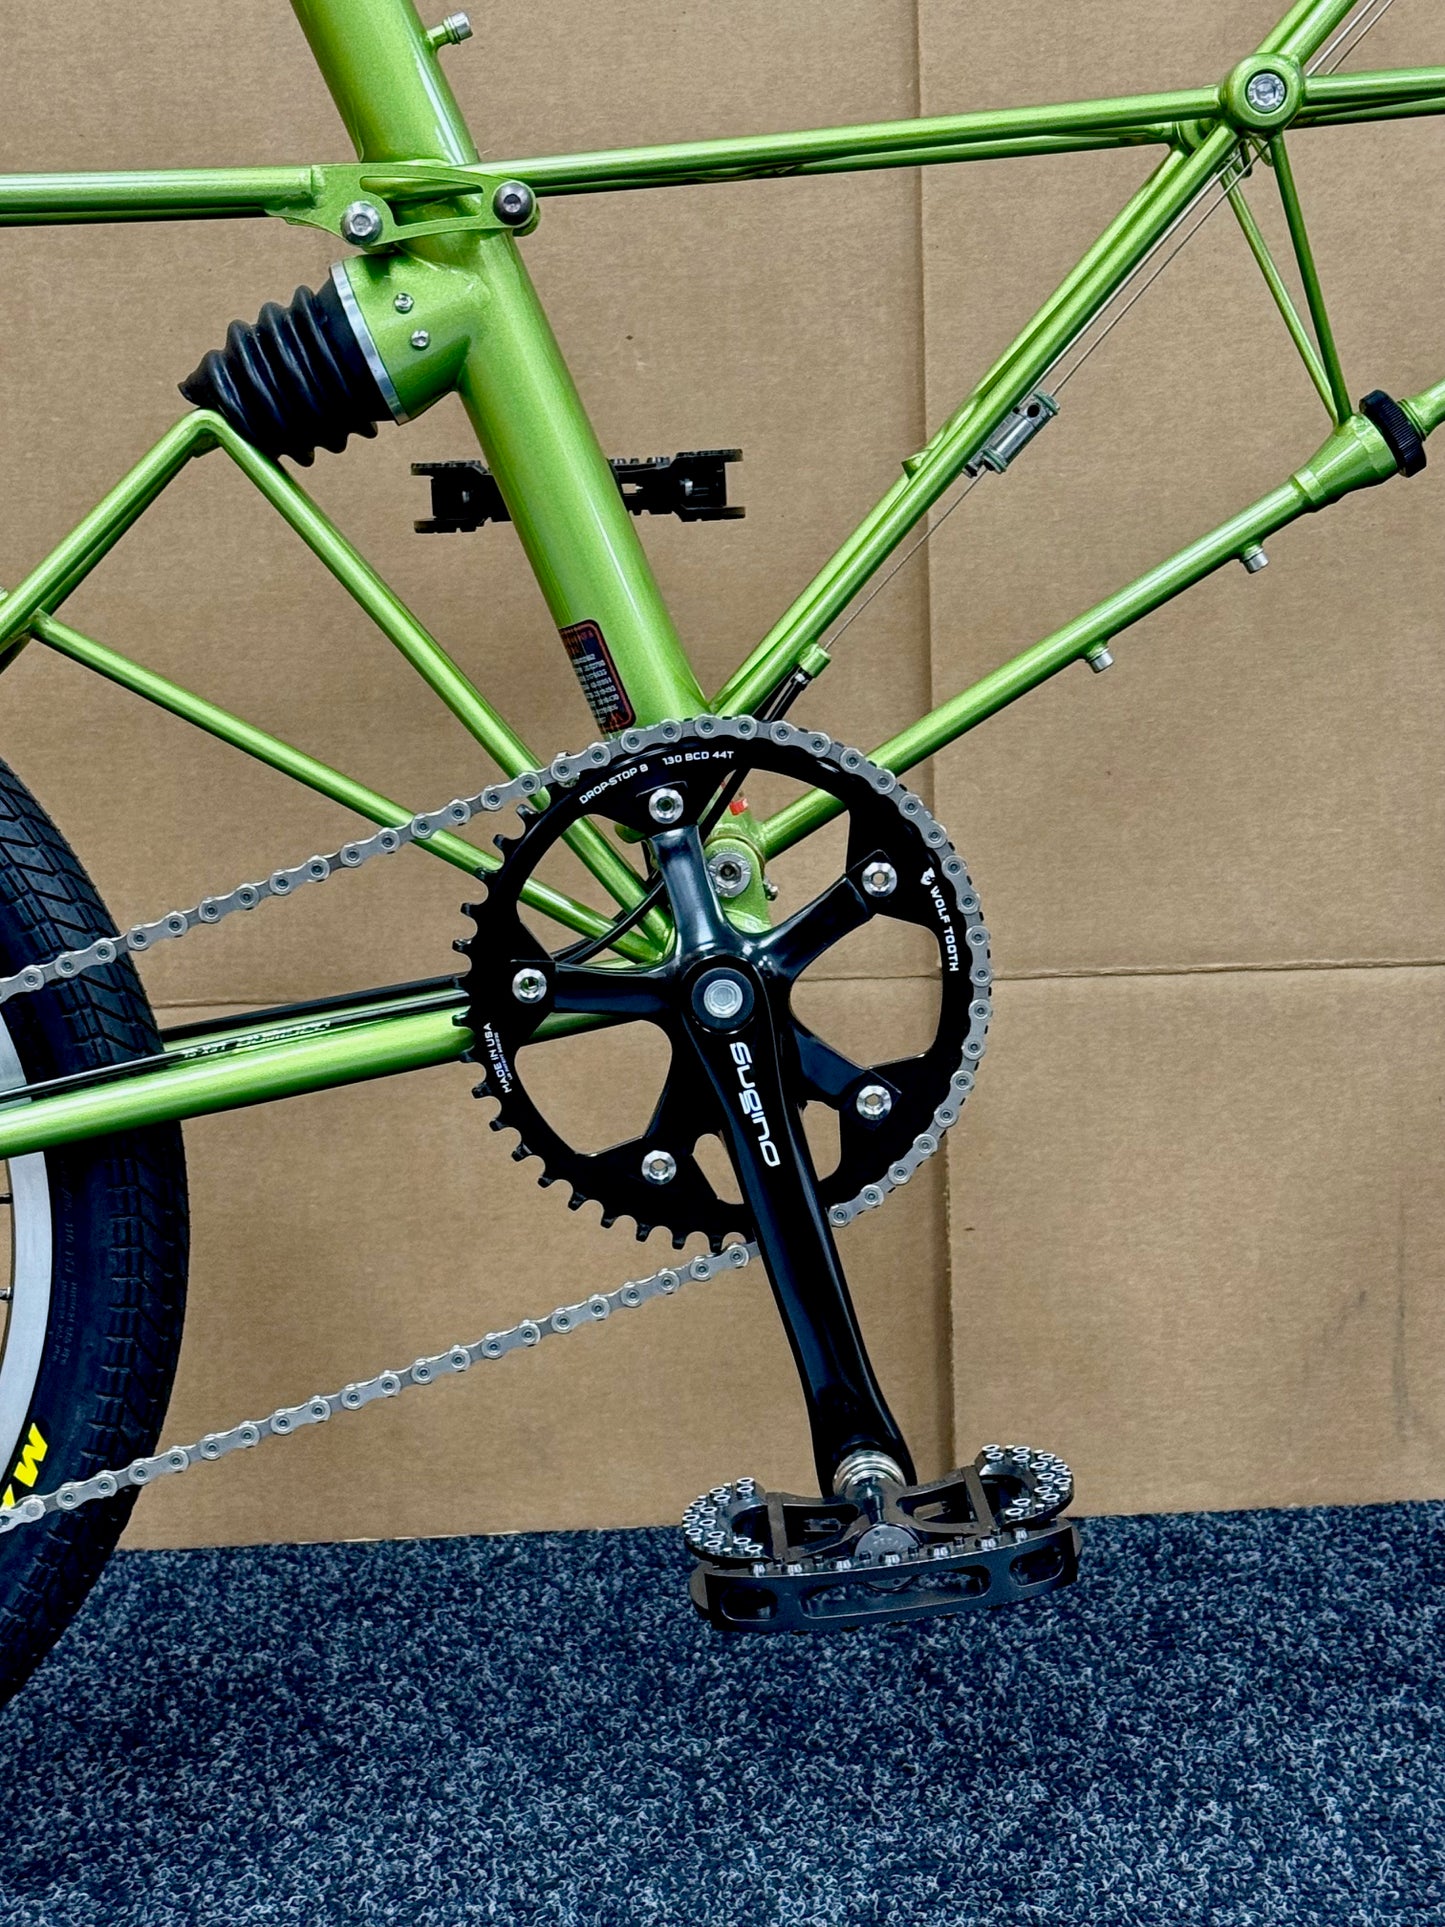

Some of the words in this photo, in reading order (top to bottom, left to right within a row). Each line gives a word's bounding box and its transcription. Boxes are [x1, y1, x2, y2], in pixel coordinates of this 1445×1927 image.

[662, 754, 682, 765] 130
[685, 751, 709, 762] BCD
[712, 750, 734, 759] 44T
[579, 767, 638, 804] DROP-STOP
[930, 885, 951, 923] WOLF
[943, 926, 959, 972] TOOTH
[483, 1022, 495, 1047] USA
[488, 1049, 499, 1060] IN
[493, 1062, 512, 1093] MADE
